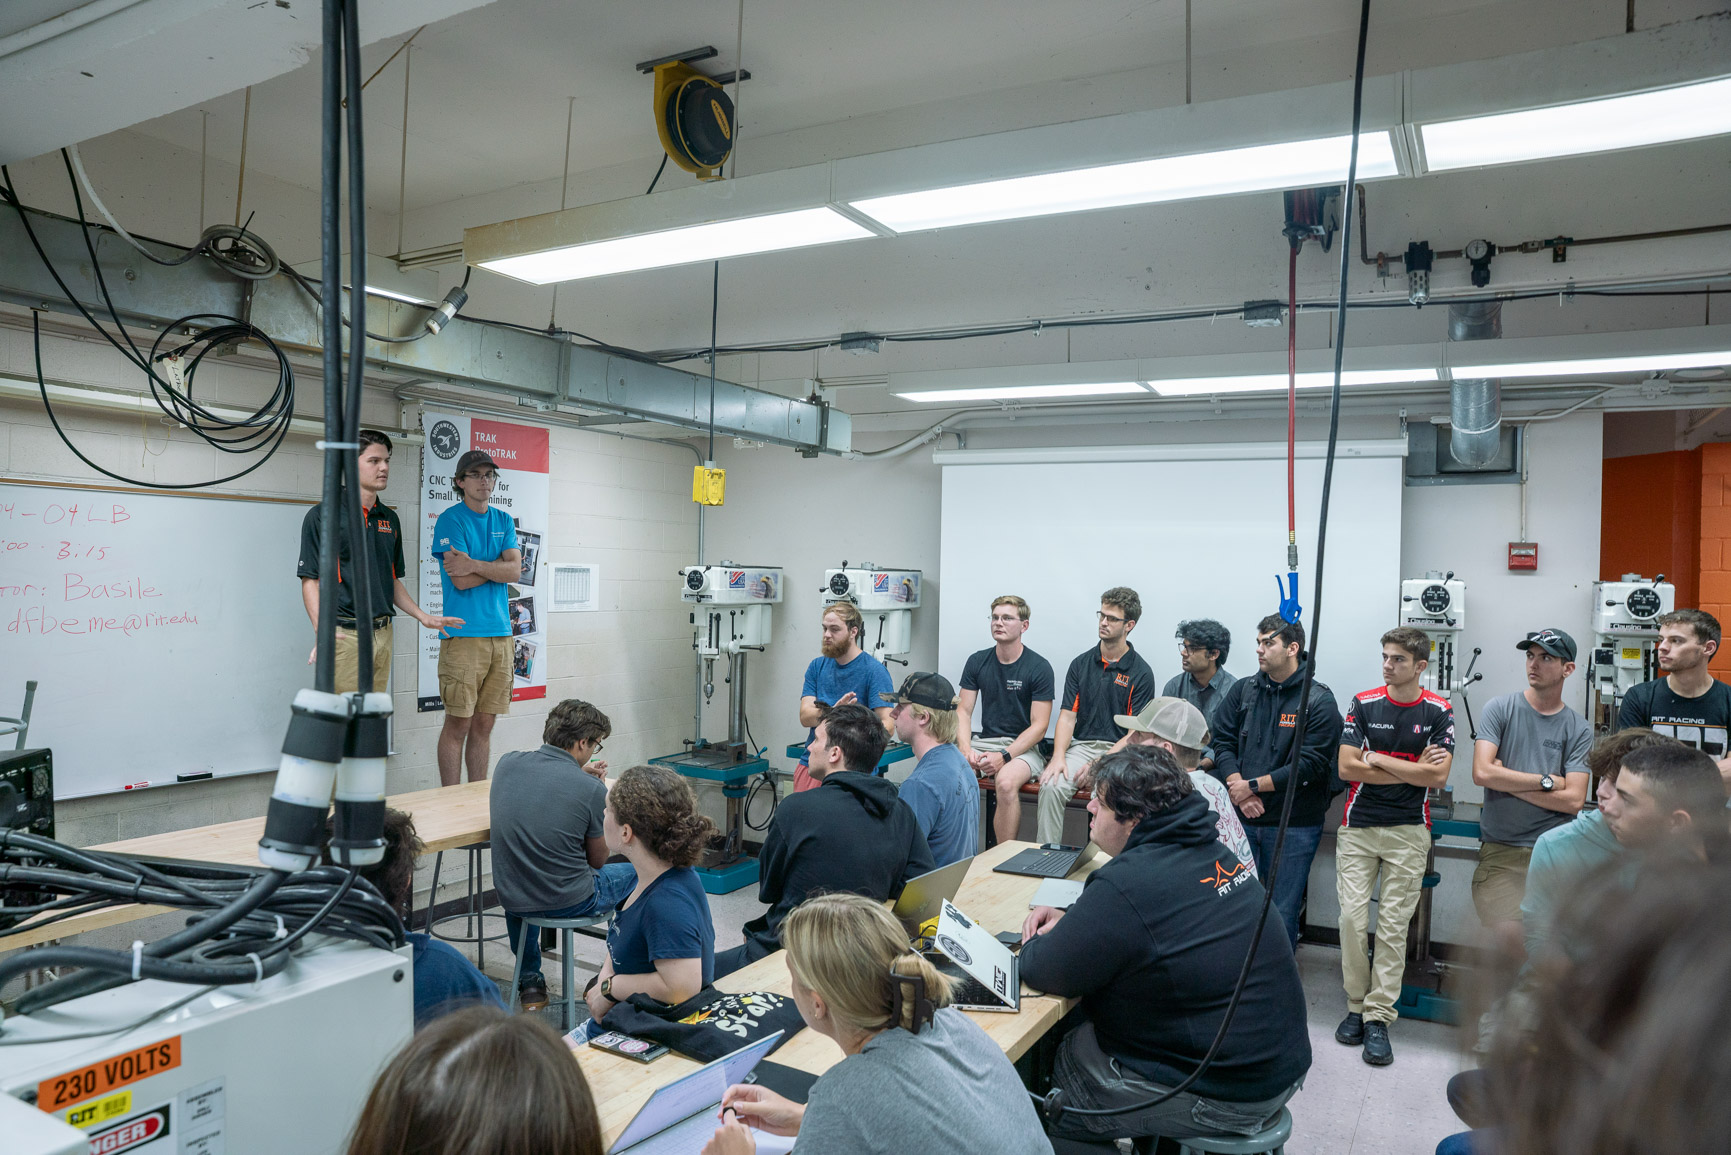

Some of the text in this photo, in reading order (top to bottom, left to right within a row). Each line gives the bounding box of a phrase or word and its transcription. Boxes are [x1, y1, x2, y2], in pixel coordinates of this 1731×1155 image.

[475, 431, 497, 444] TRAK
[429, 475, 446, 486] CNC
[498, 481, 510, 492] for
[428, 489, 453, 501] Small
[1115, 672, 1130, 684] RIT
[1280, 713, 1297, 722] RIT
[1668, 716, 1706, 725] RACING
[1371, 722, 1395, 730] ACURA
[54, 1044, 171, 1105] 230 VOLTS
